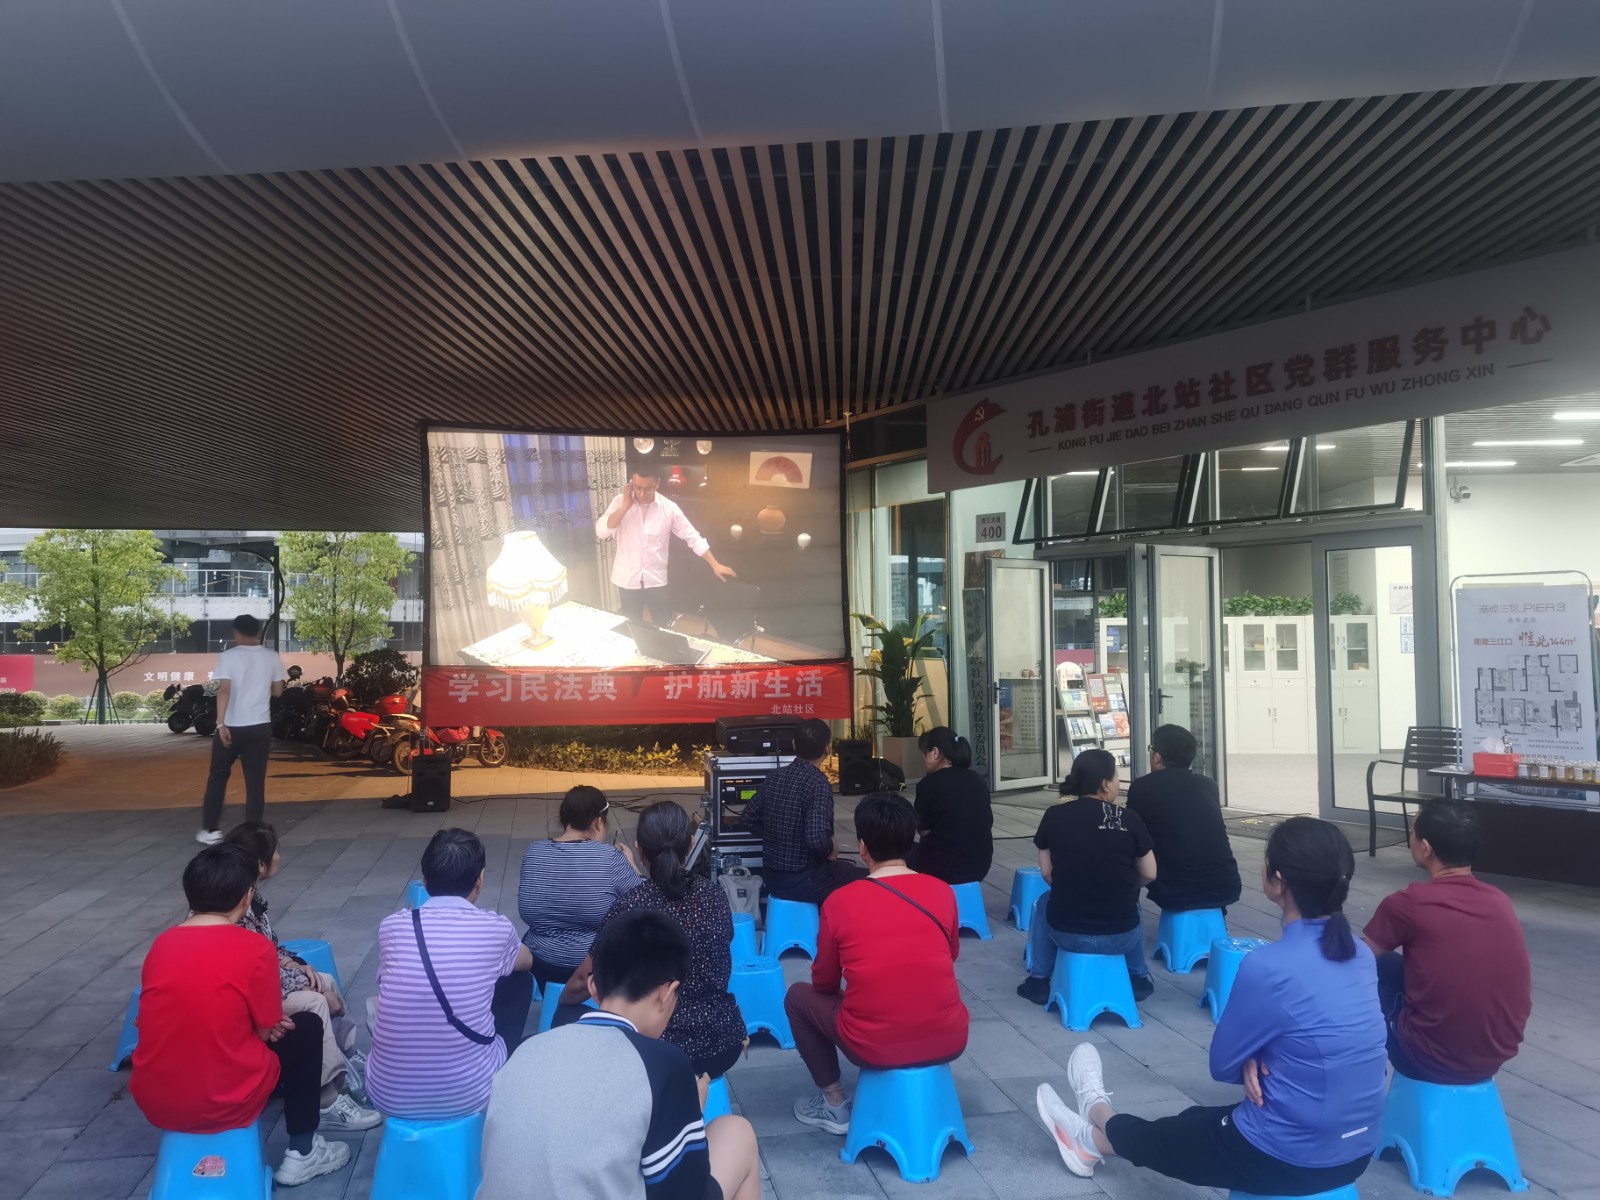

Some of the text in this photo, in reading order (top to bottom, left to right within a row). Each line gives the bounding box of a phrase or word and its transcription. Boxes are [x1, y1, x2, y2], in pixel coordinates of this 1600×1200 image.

[1027, 305, 1553, 440] 孔浦街道北站社区党群服务中心
[1057, 362, 1495, 451] KONG PU JIE DAO BEI ZHAN SHE QU DANG QUN FU WU ZHONG XIN
[981, 526, 1002, 539] 400
[143, 671, 196, 682] 文明健康
[448, 669, 825, 703] 学习民法典 护航新生活
[771, 704, 815, 715] 北站社区
[968, 642, 987, 767] 站社区居务监督委员会
